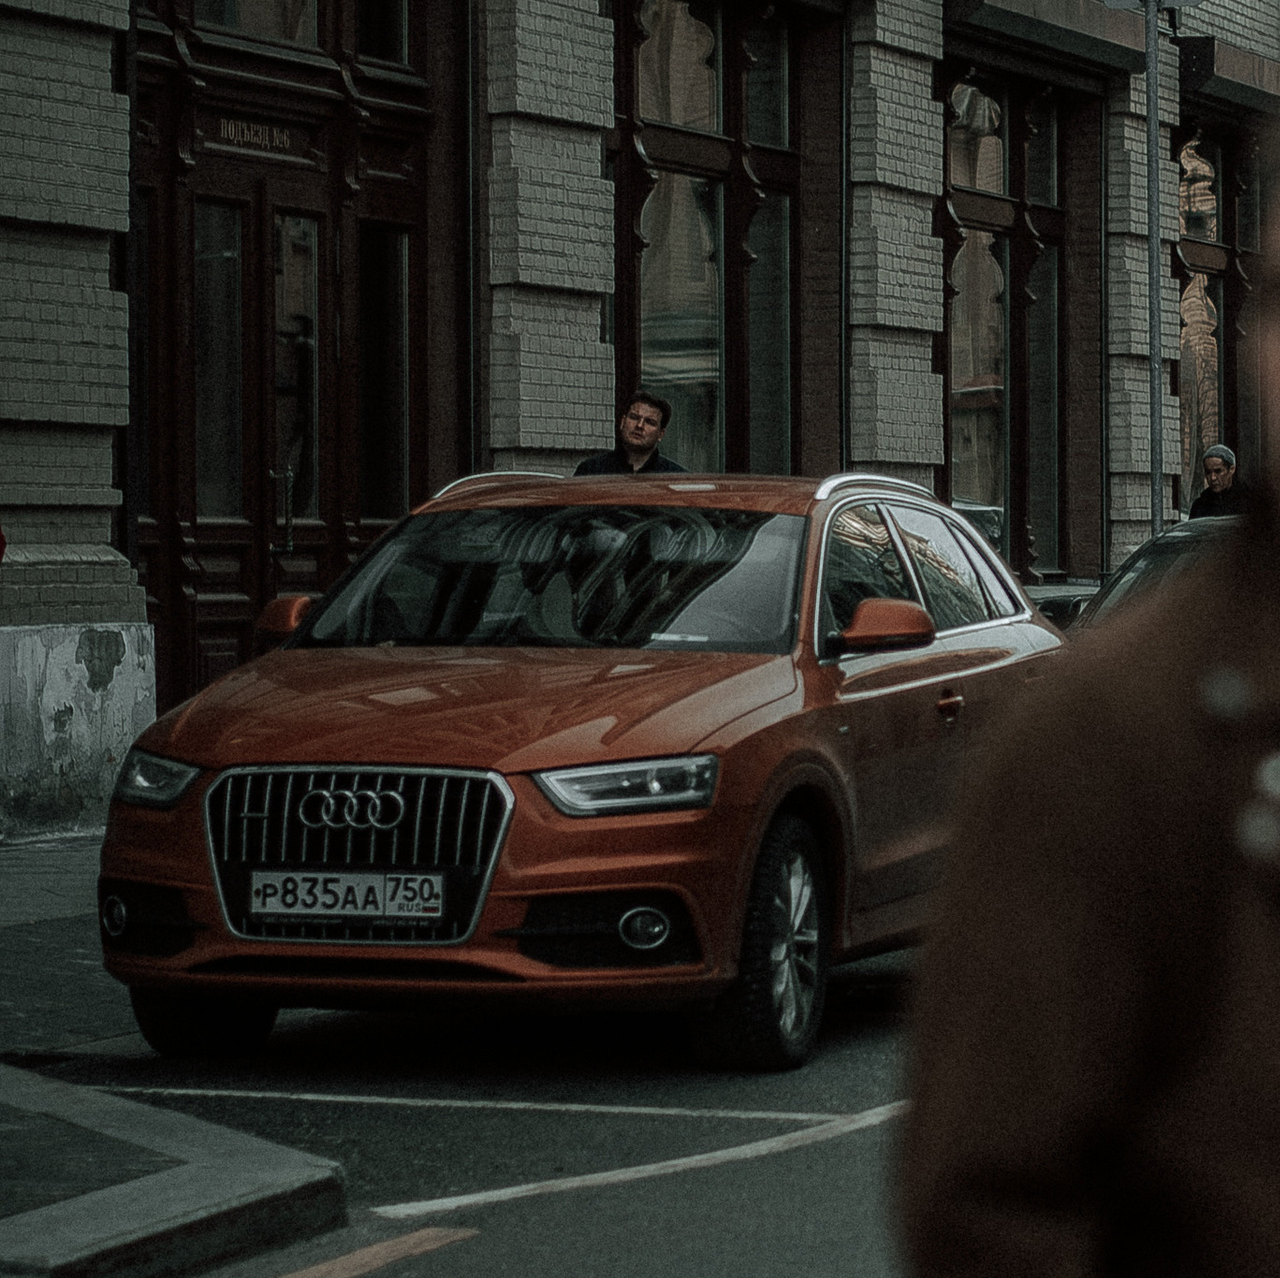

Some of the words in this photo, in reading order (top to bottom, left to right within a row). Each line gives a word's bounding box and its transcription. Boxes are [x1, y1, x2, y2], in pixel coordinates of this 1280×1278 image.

[220, 118, 270, 150] ПОДЪЕЗД
[387, 877, 434, 902] 750
[397, 902, 422, 913] RUS
